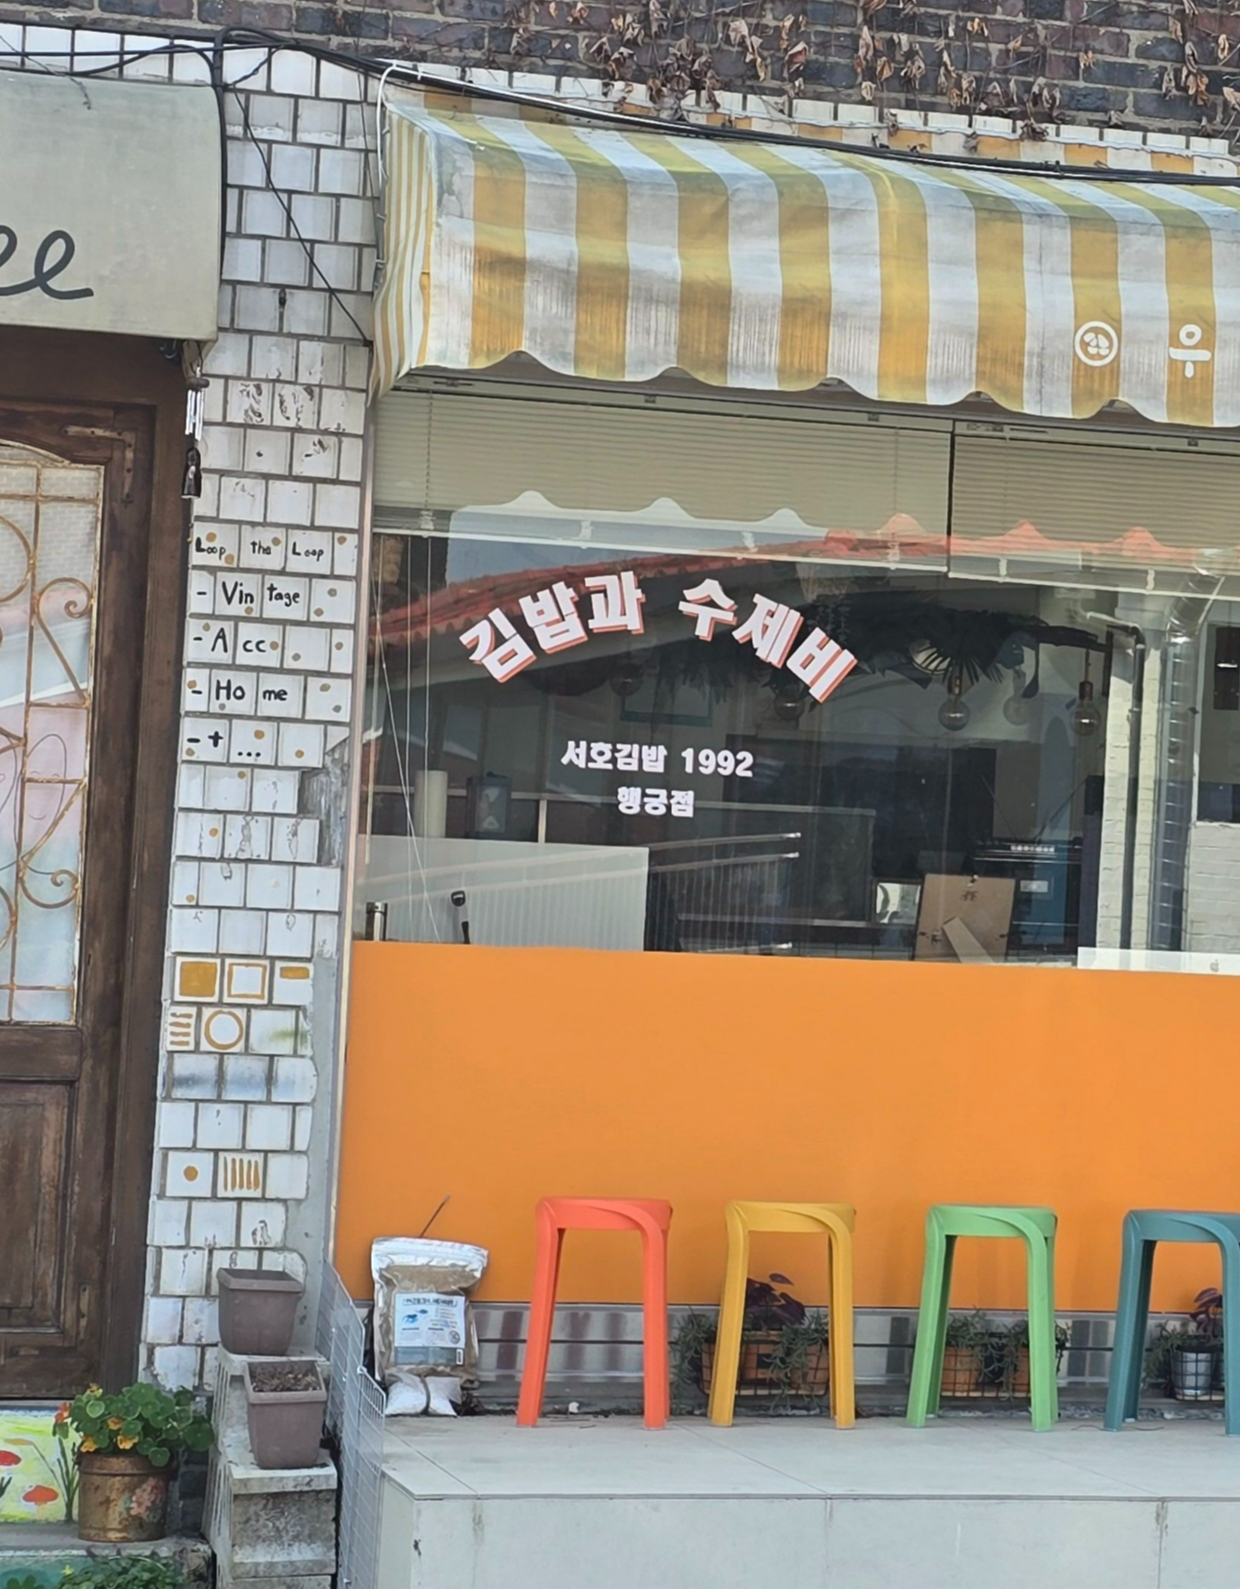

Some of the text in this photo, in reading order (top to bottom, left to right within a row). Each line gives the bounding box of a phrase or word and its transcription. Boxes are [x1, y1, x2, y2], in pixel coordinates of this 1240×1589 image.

[194, 536, 226, 561] Loop
[291, 541, 325, 562] Loop
[221, 580, 301, 607] Vintage
[210, 627, 267, 654] Acc
[458, 571, 859, 704] 김밥과 수제비
[214, 677, 289, 702] Home
[560, 740, 754, 778] 서호김밥 1992
[616, 786, 695, 818] 행궁점
